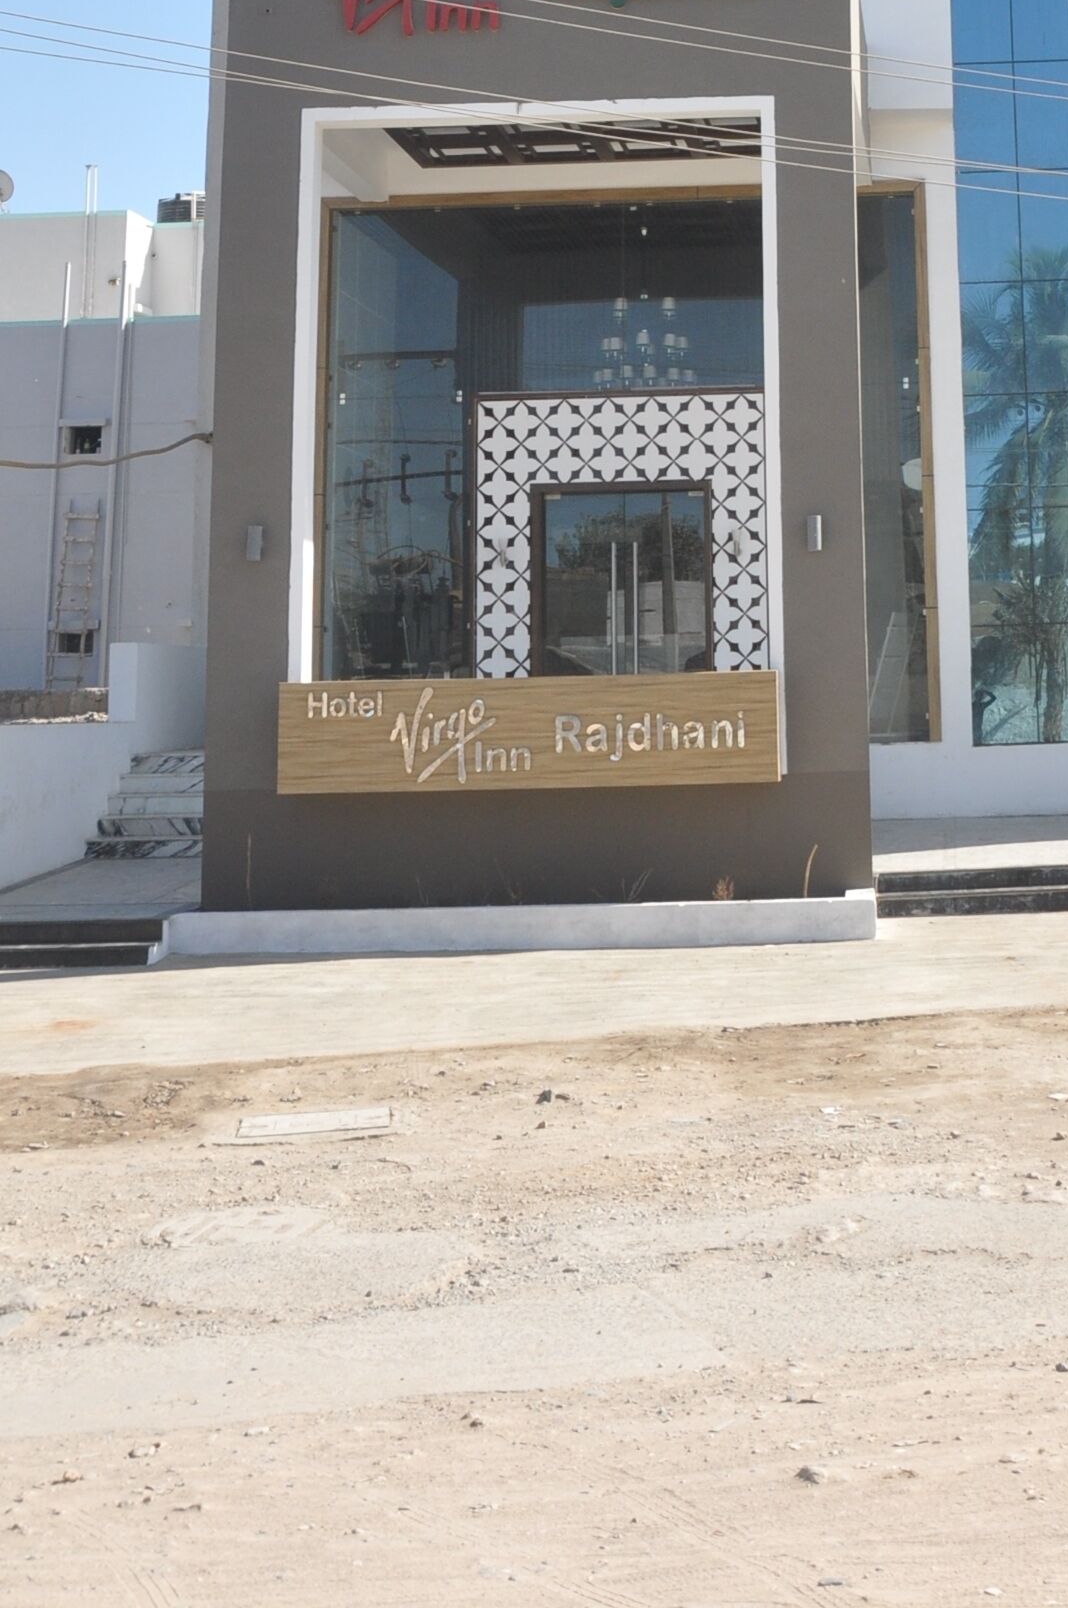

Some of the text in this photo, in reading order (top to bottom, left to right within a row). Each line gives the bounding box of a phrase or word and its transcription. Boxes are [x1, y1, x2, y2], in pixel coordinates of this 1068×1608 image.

[306, 687, 746, 783] Hotel Virgo Rajdhani
[473, 740, 533, 772] Inn
